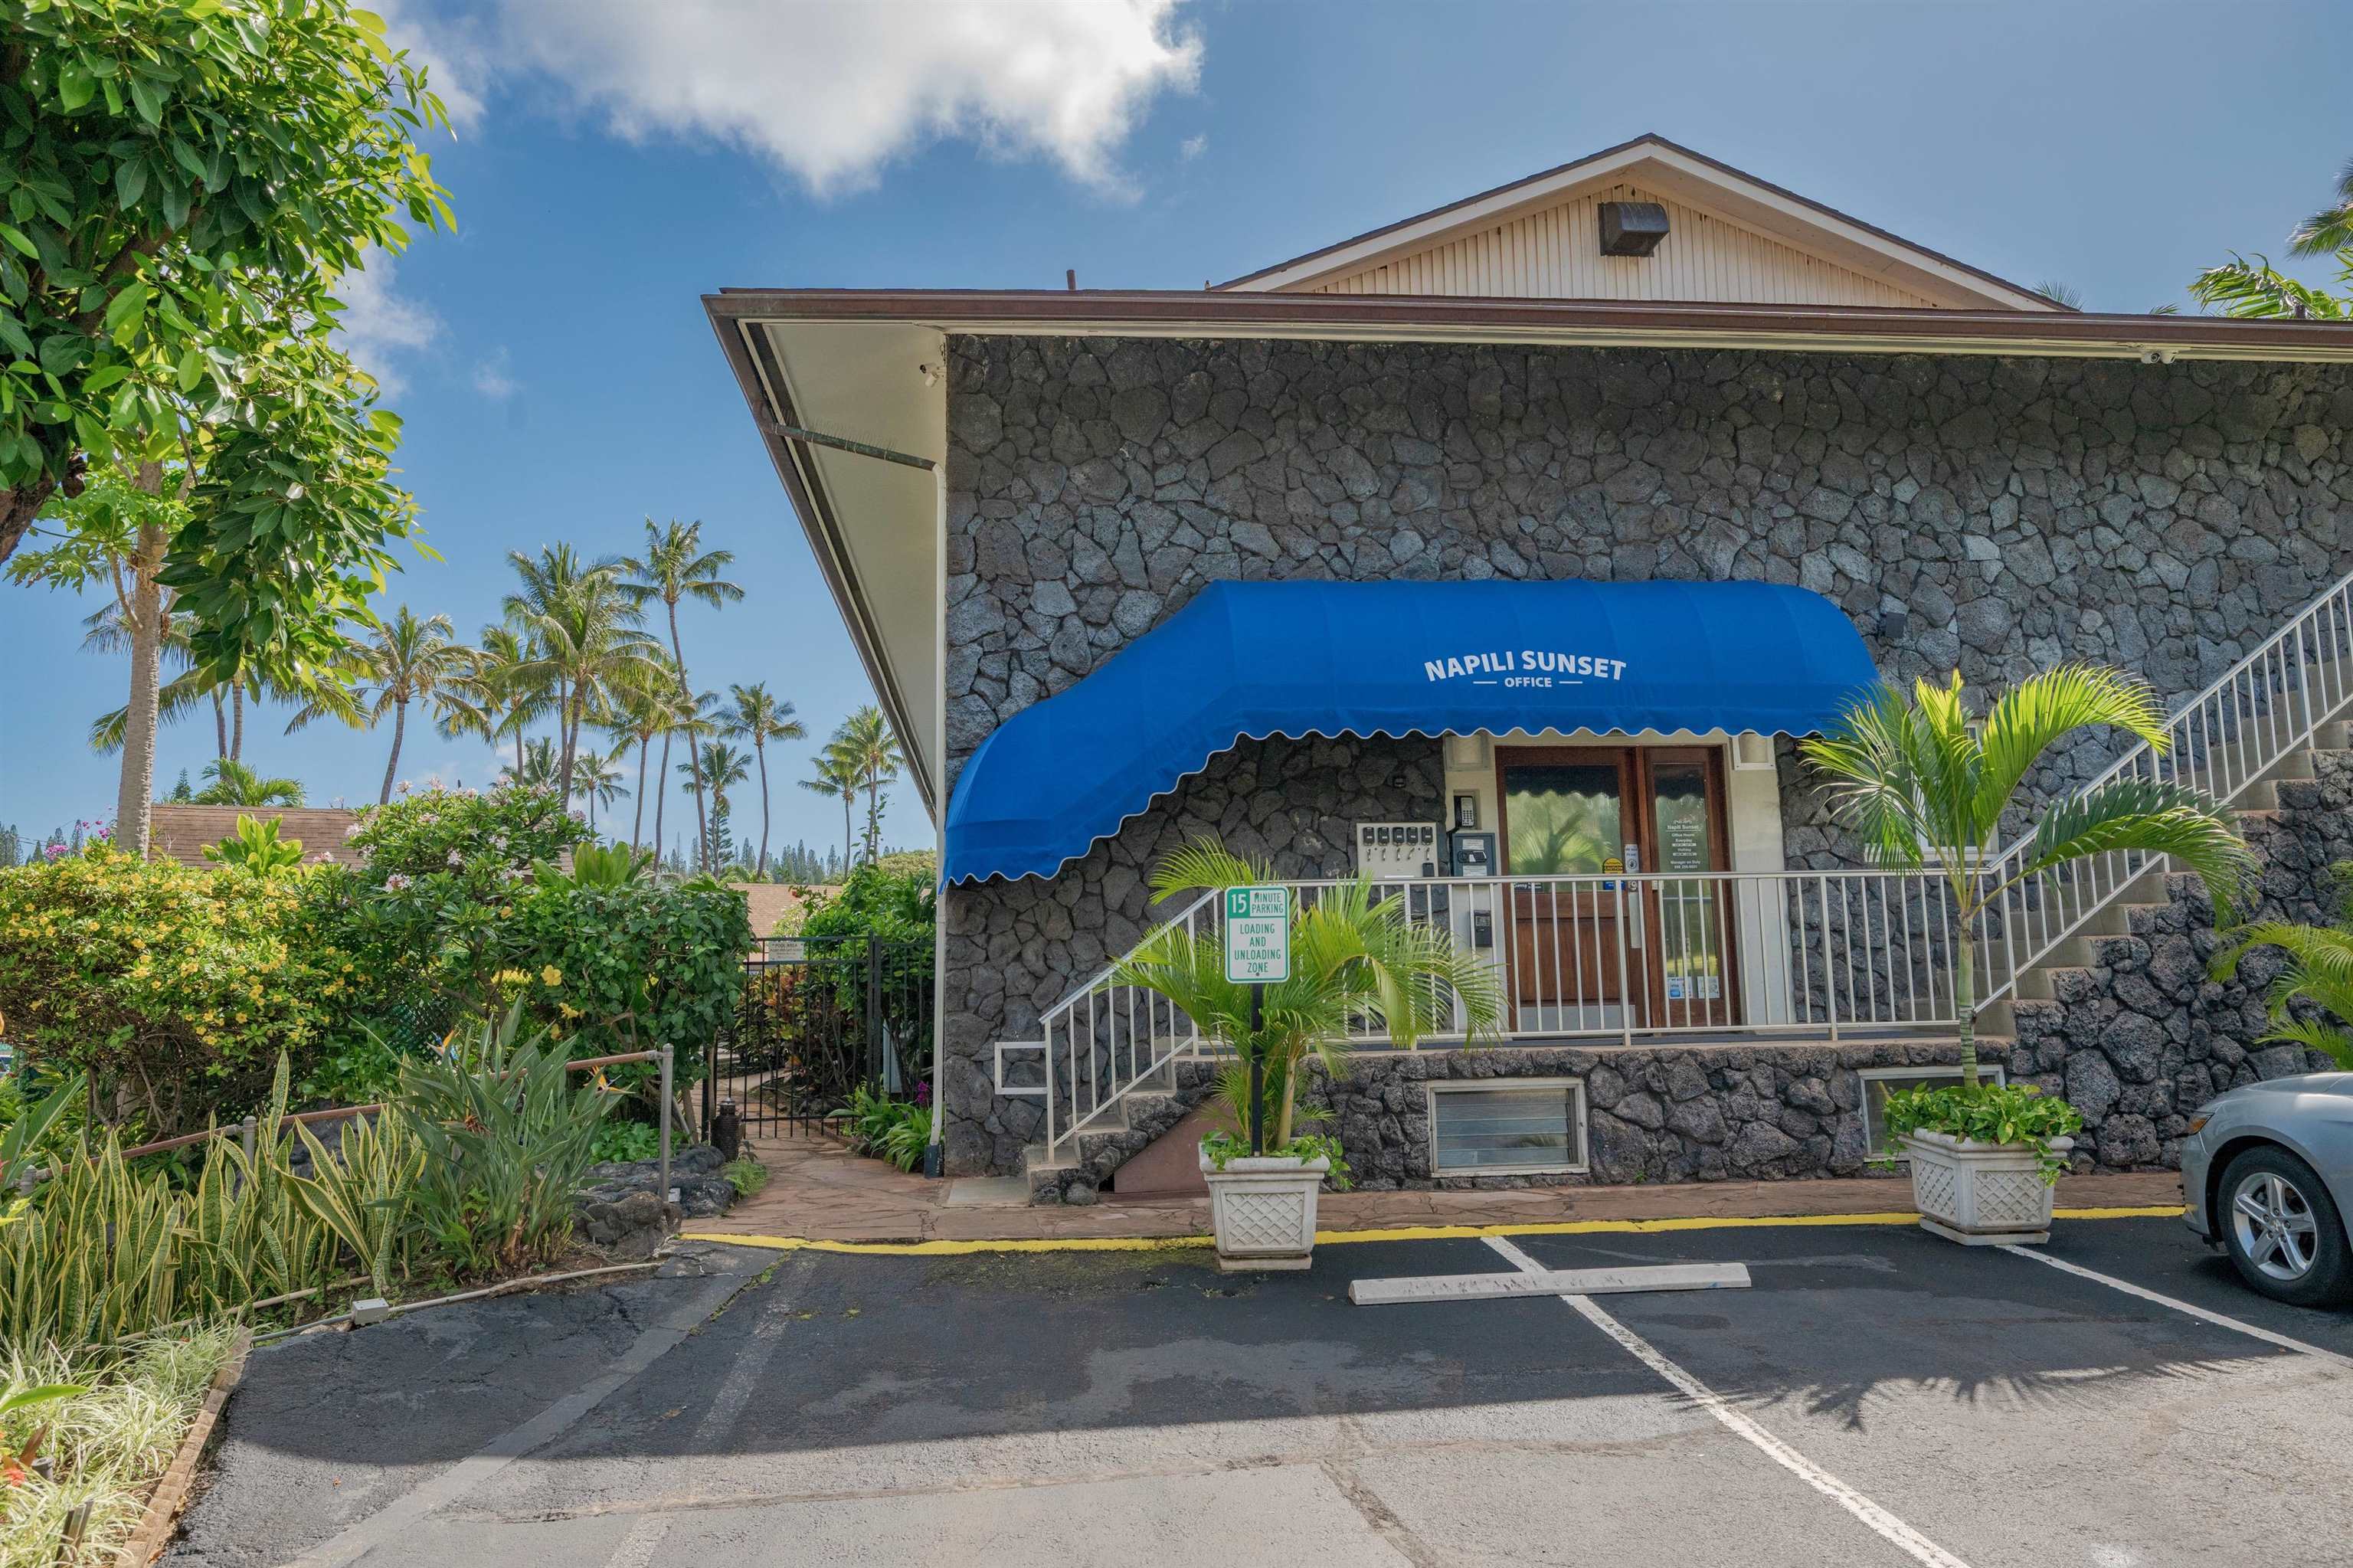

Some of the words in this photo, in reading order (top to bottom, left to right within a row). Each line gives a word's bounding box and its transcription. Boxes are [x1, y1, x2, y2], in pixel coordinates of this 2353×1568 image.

[1424, 651, 1514, 682] NAPILI
[1521, 650, 1627, 681] SUNSET
[1504, 677, 1553, 688] OFFICE
[1254, 892, 1281, 902] MINUTE
[1232, 893, 1247, 914] 15
[1252, 903, 1284, 914] PARKING
[1239, 924, 1275, 935] LOADING
[1249, 936, 1266, 947] AND
[1234, 949, 1281, 961] UNLOADING
[1247, 962, 1268, 973] ZONE
